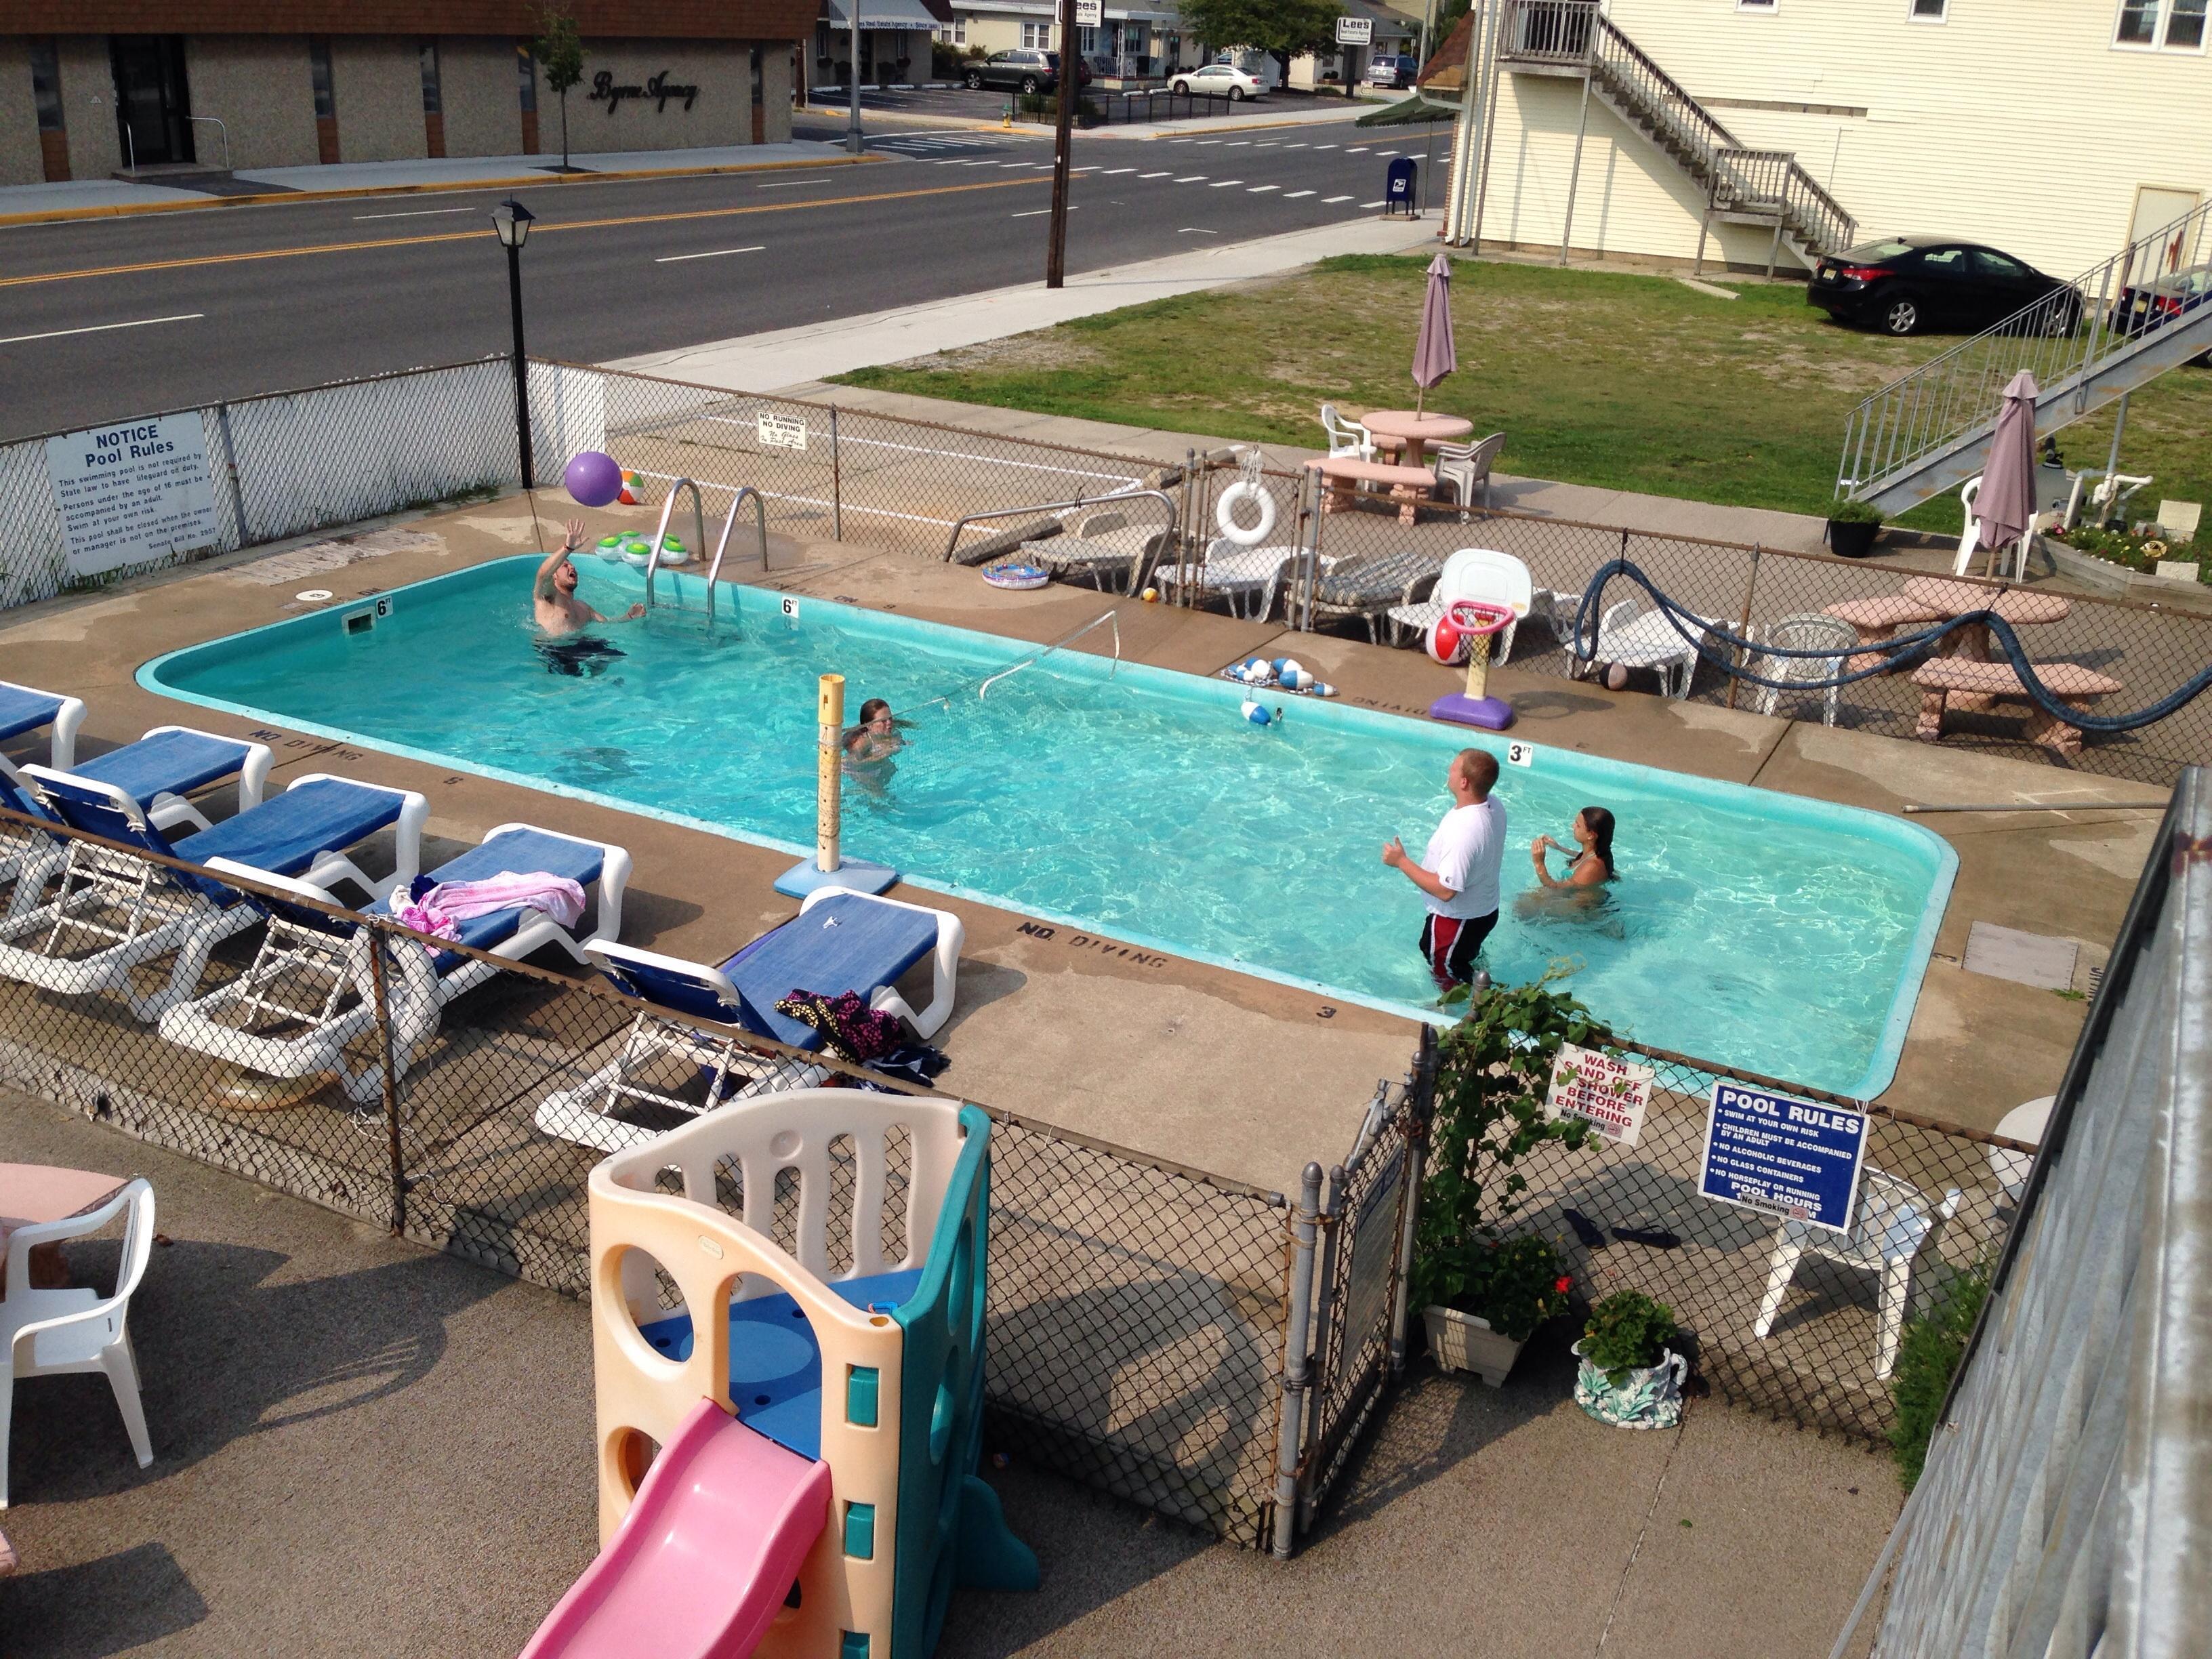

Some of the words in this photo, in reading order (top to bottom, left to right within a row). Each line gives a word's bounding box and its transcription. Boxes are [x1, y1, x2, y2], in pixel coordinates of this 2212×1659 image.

[1343, 19, 1370, 29] Lees
[773, 415, 804, 426] RUNNING
[776, 422, 800, 432] DIVING
[96, 424, 159, 449] NOTICE
[85, 448, 123, 468] Pool
[129, 441, 174, 459] Rules
[58, 478, 75, 488] This
[79, 470, 116, 483] swimming
[119, 466, 136, 476] pool
[148, 461, 160, 469] not
[162, 455, 191, 468] required
[60, 488, 81, 498] State
[84, 485, 98, 493] law
[112, 478, 130, 487] have
[136, 468, 168, 482] lifeguard
[63, 499, 95, 512] Persons
[98, 494, 119, 504] under
[122, 490, 135, 499] the
[138, 488, 151, 496] age
[175, 478, 192, 487] must
[66, 506, 117, 522] accompanied
[119, 501, 128, 510] by
[68, 521, 89, 532] Swim
[104, 515, 120, 525] your
[123, 511, 139, 520] own
[70, 536, 85, 545] This
[89, 531, 105, 542] pool
[107, 527, 123, 537] shall
[125, 524, 134, 532] be
[137, 519, 159, 529] closed
[161, 514, 179, 524] when
[181, 510, 192, 518] the
[194, 507, 213, 516] owner
[84, 539, 117, 553] manager
[129, 533, 142, 541] not
[144, 530, 154, 538] on
[156, 527, 167, 535] the
[148, 540, 171, 550] Senate
[174, 535, 185, 543] Bill
[377, 600, 386, 616] 6
[783, 599, 792, 614] 6
[1352, 696, 1427, 715] DIVING
[248, 729, 282, 741] NO
[283, 739, 365, 761] DIVING
[1510, 745, 1522, 762] 3
[1016, 922, 1056, 941] NO
[1069, 935, 1168, 968] DIVING
[1315, 1006, 1337, 1019] 3
[1563, 1061, 1606, 1082] SAND
[1584, 1054, 1629, 1076] WASH
[1567, 1086, 1627, 1113] BEFORE
[1577, 1076, 1644, 1106] SHOWER
[1555, 1095, 1633, 1127] ENTERING
[1560, 1109, 1572, 1118] No
[1721, 1090, 1781, 1118] POOL
[1788, 1105, 1860, 1135] RULES
[1723, 1109, 1745, 1120] SWIM
[1746, 1115, 1757, 1123] AT
[1757, 1117, 1779, 1128] YOUR
[1780, 1122, 1799, 1133] OWN
[1800, 1127, 1820, 1138] RISK
[1720, 1129, 1732, 1137] BY
[1732, 1132, 1744, 1141] AN
[1744, 1135, 1770, 1147] ADULT
[1721, 1122, 1760, 1137] CHILDREN
[1761, 1130, 1784, 1143] MUST
[1784, 1137, 1795, 1147] BE
[1796, 1140, 1853, 1160] ACCOMPANIED
[1716, 1154, 1729, 1164] NO
[1729, 1159, 1755, 1171] GLASS
[1756, 1165, 1805, 1184] CONTAINERS
[1718, 1142, 1730, 1151] NO
[1732, 1145, 1776, 1162] ALCOHOLIC
[1776, 1157, 1823, 1174] BEVERAGES
[1714, 1168, 1727, 1178] NO
[1727, 1171, 1772, 1189] HORSEPLAY
[1772, 1183, 1785, 1193] OR
[1785, 1187, 1821, 1202] RUNNING
[1729, 1181, 1769, 1198] POOL
[1772, 1191, 1823, 1212] HOURS
[1742, 1195, 1753, 1205] No
[1753, 1198, 1790, 1216] Smoking
